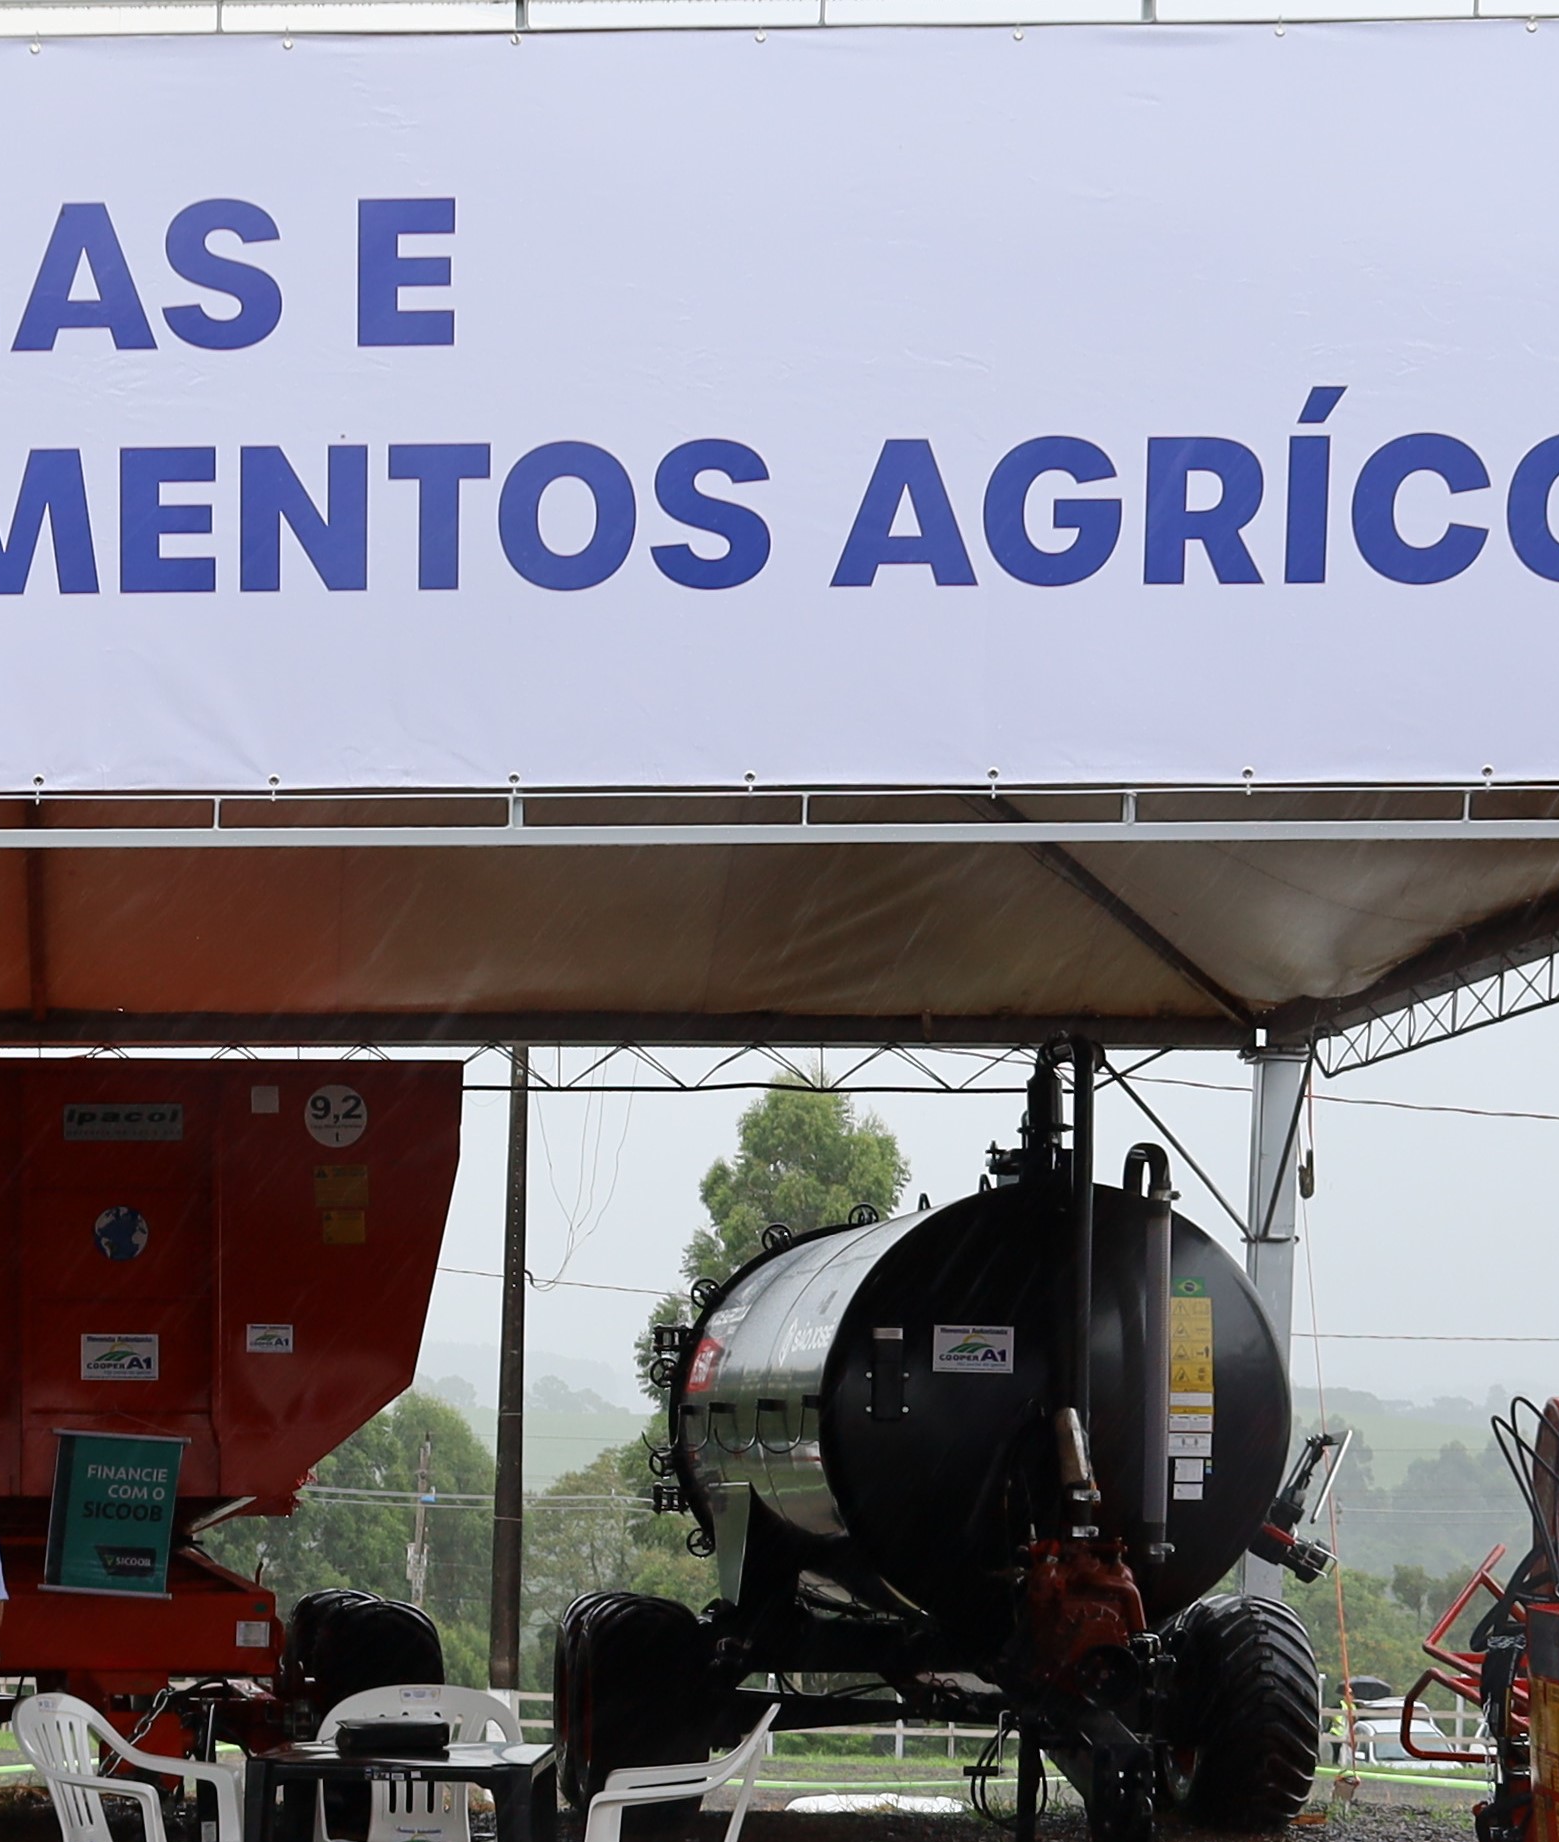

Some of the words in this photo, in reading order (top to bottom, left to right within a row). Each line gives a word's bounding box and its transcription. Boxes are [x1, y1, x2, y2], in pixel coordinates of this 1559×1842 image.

[358, 198, 456, 347] E
[67, 1108, 179, 1126] Ipacol
[310, 1094, 362, 1125] 9,2
[126, 1356, 153, 1370] A1
[980, 1348, 1007, 1363] A1
[87, 1464, 168, 1483] FINANCIE
[108, 1484, 148, 1500] COM
[152, 1486, 165, 1500] O
[82, 1500, 163, 1522] SICOOB
